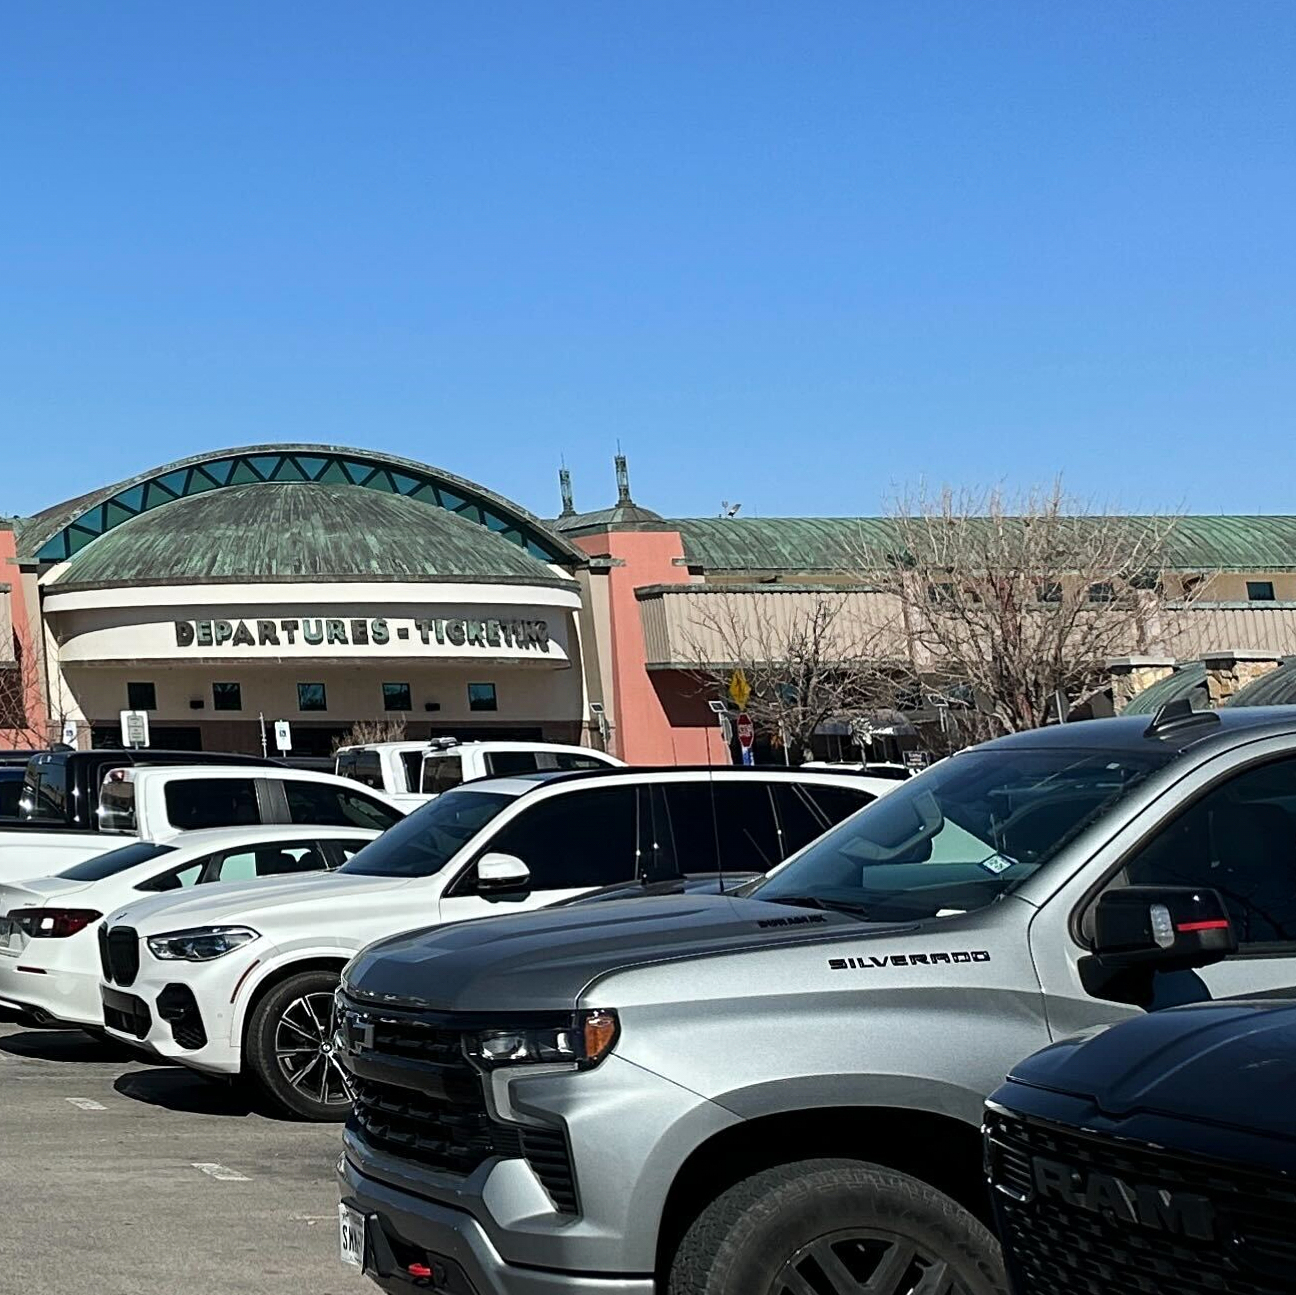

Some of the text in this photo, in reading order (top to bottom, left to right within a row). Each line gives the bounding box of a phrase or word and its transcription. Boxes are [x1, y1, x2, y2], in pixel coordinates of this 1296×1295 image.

[176, 619, 389, 647] DEPARTURES
[415, 619, 550, 653] TICKETING
[828, 951, 991, 970] SILVERADO
[1031, 1155, 1214, 1241] RAM
